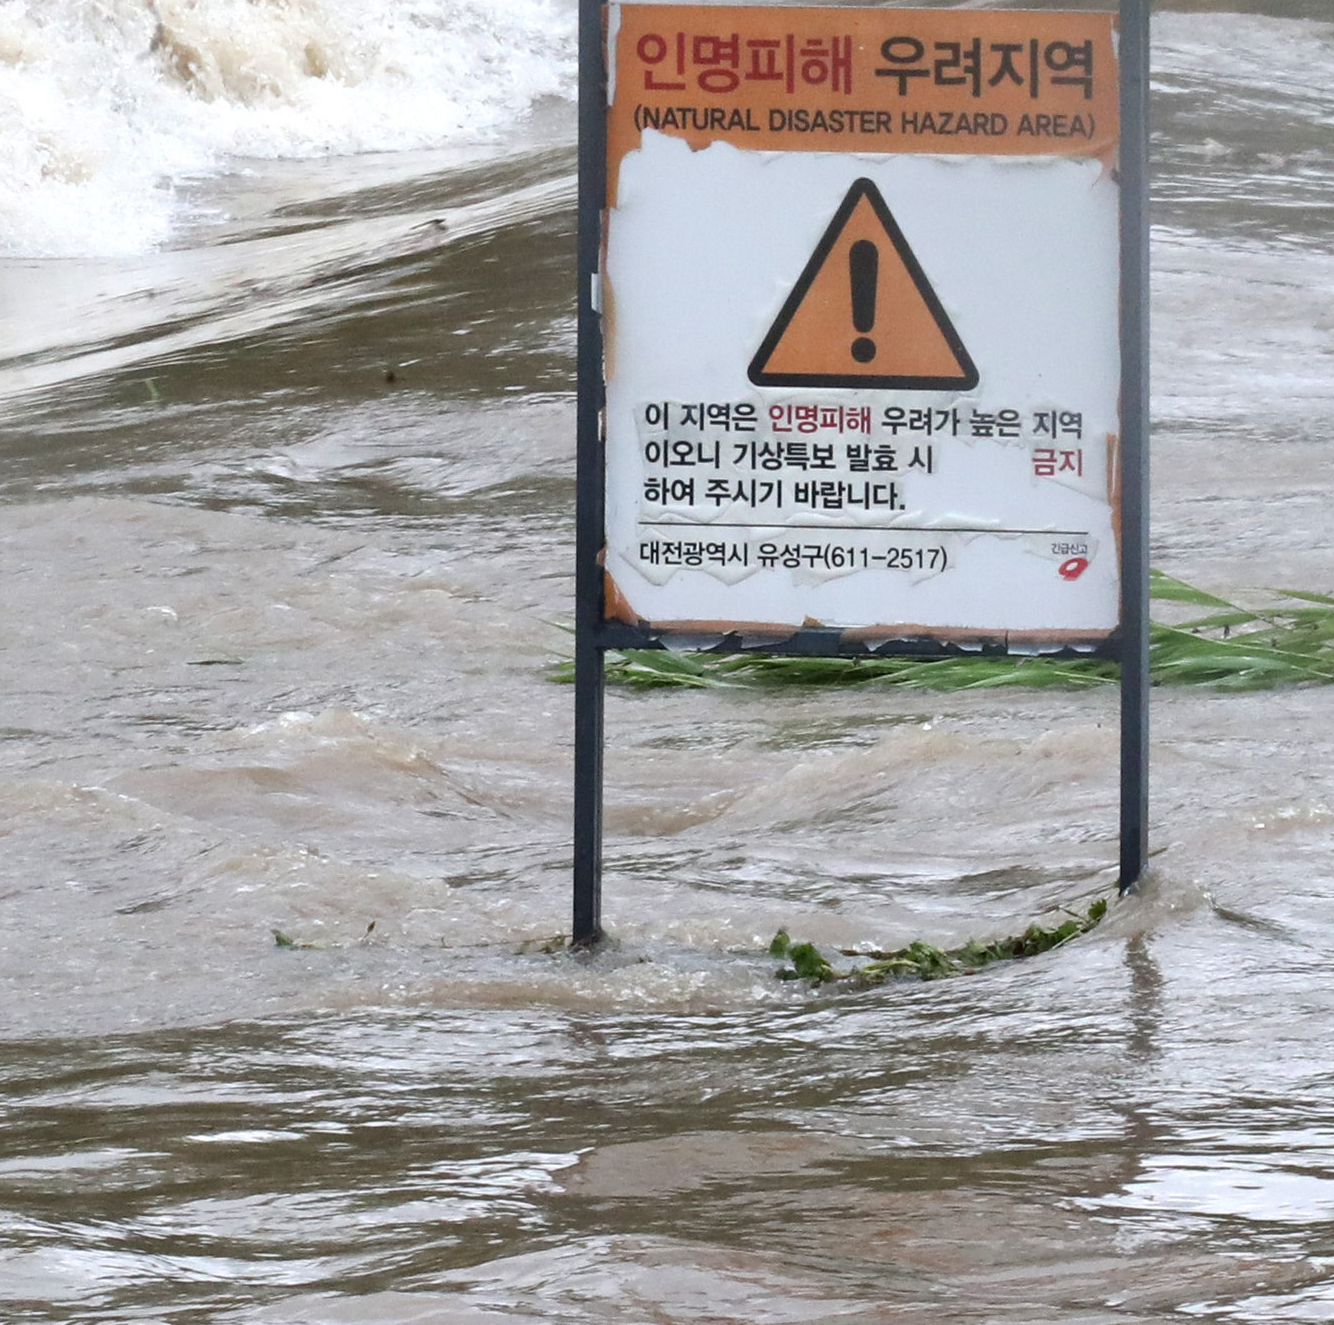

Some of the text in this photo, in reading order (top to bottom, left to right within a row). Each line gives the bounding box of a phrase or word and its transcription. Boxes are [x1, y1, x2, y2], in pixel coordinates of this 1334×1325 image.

[636, 32, 1093, 100] 인명피해 우려지역
[634, 104, 1096, 140] (NATURAL DISASTER HAZARD AREA)
[645, 403, 1084, 440] 이 지역은 인명피해 우려가 높은 지역
[645, 441, 1084, 478] 이오니 기상특보 발효 시 금지
[644, 478, 905, 511] 하여 주시기 바랍니다.
[639, 541, 749, 568] 대전광역시
[1051, 543, 1088, 555] 긴급신고
